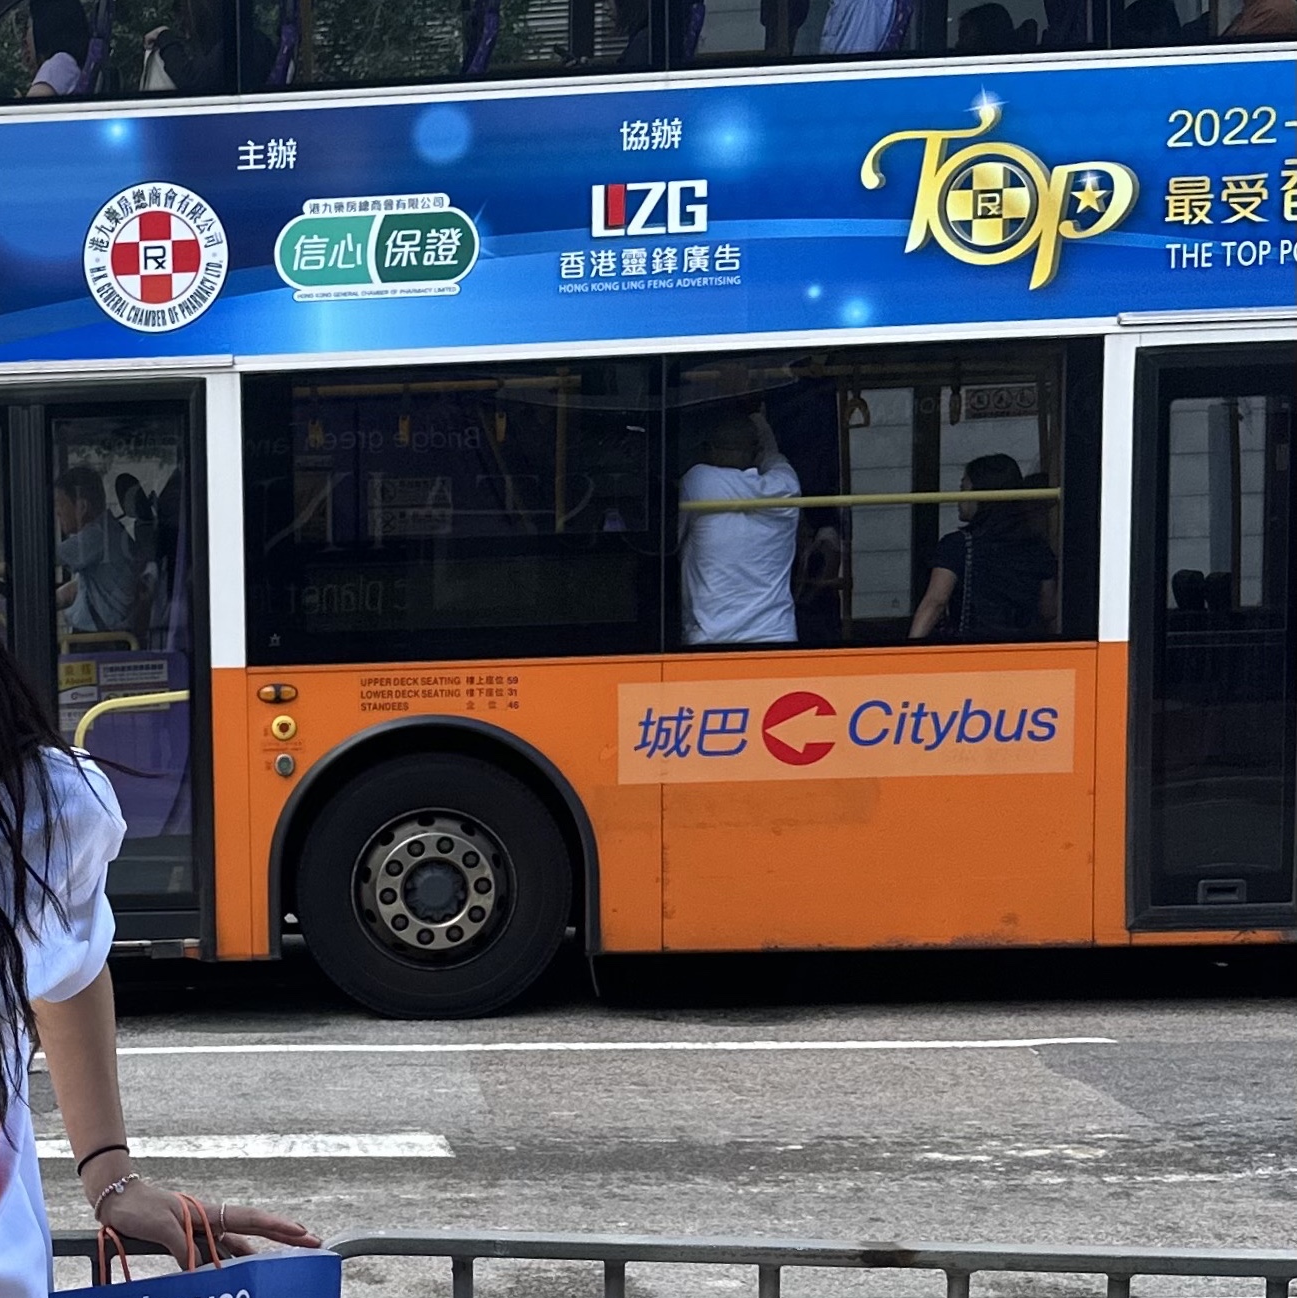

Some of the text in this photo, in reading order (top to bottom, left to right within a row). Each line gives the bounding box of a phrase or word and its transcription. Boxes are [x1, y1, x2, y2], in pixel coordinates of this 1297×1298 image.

[620, 117, 682, 151] 協辦
[237, 138, 297, 170] 主辦
[292, 227, 464, 272] 信心 保證
[559, 243, 742, 279] 香港靈鋒廣告
[1165, 239, 1296, 269] THE TOP P
[559, 275, 742, 294] HONG KONG LING FENG ADVERTISING
[96, 281, 128, 319] GENERAL
[126, 305, 168, 328] CHAMBER
[168, 306, 181, 325] OF
[177, 278, 219, 320] PHARMACY
[360, 676, 461, 687] UPPER DECK SEATING
[360, 688, 461, 700] LOWER DECK SEATING
[360, 701, 409, 712] STANDEES
[633, 706, 750, 759] 城巴
[847, 698, 1059, 750] Citybus
